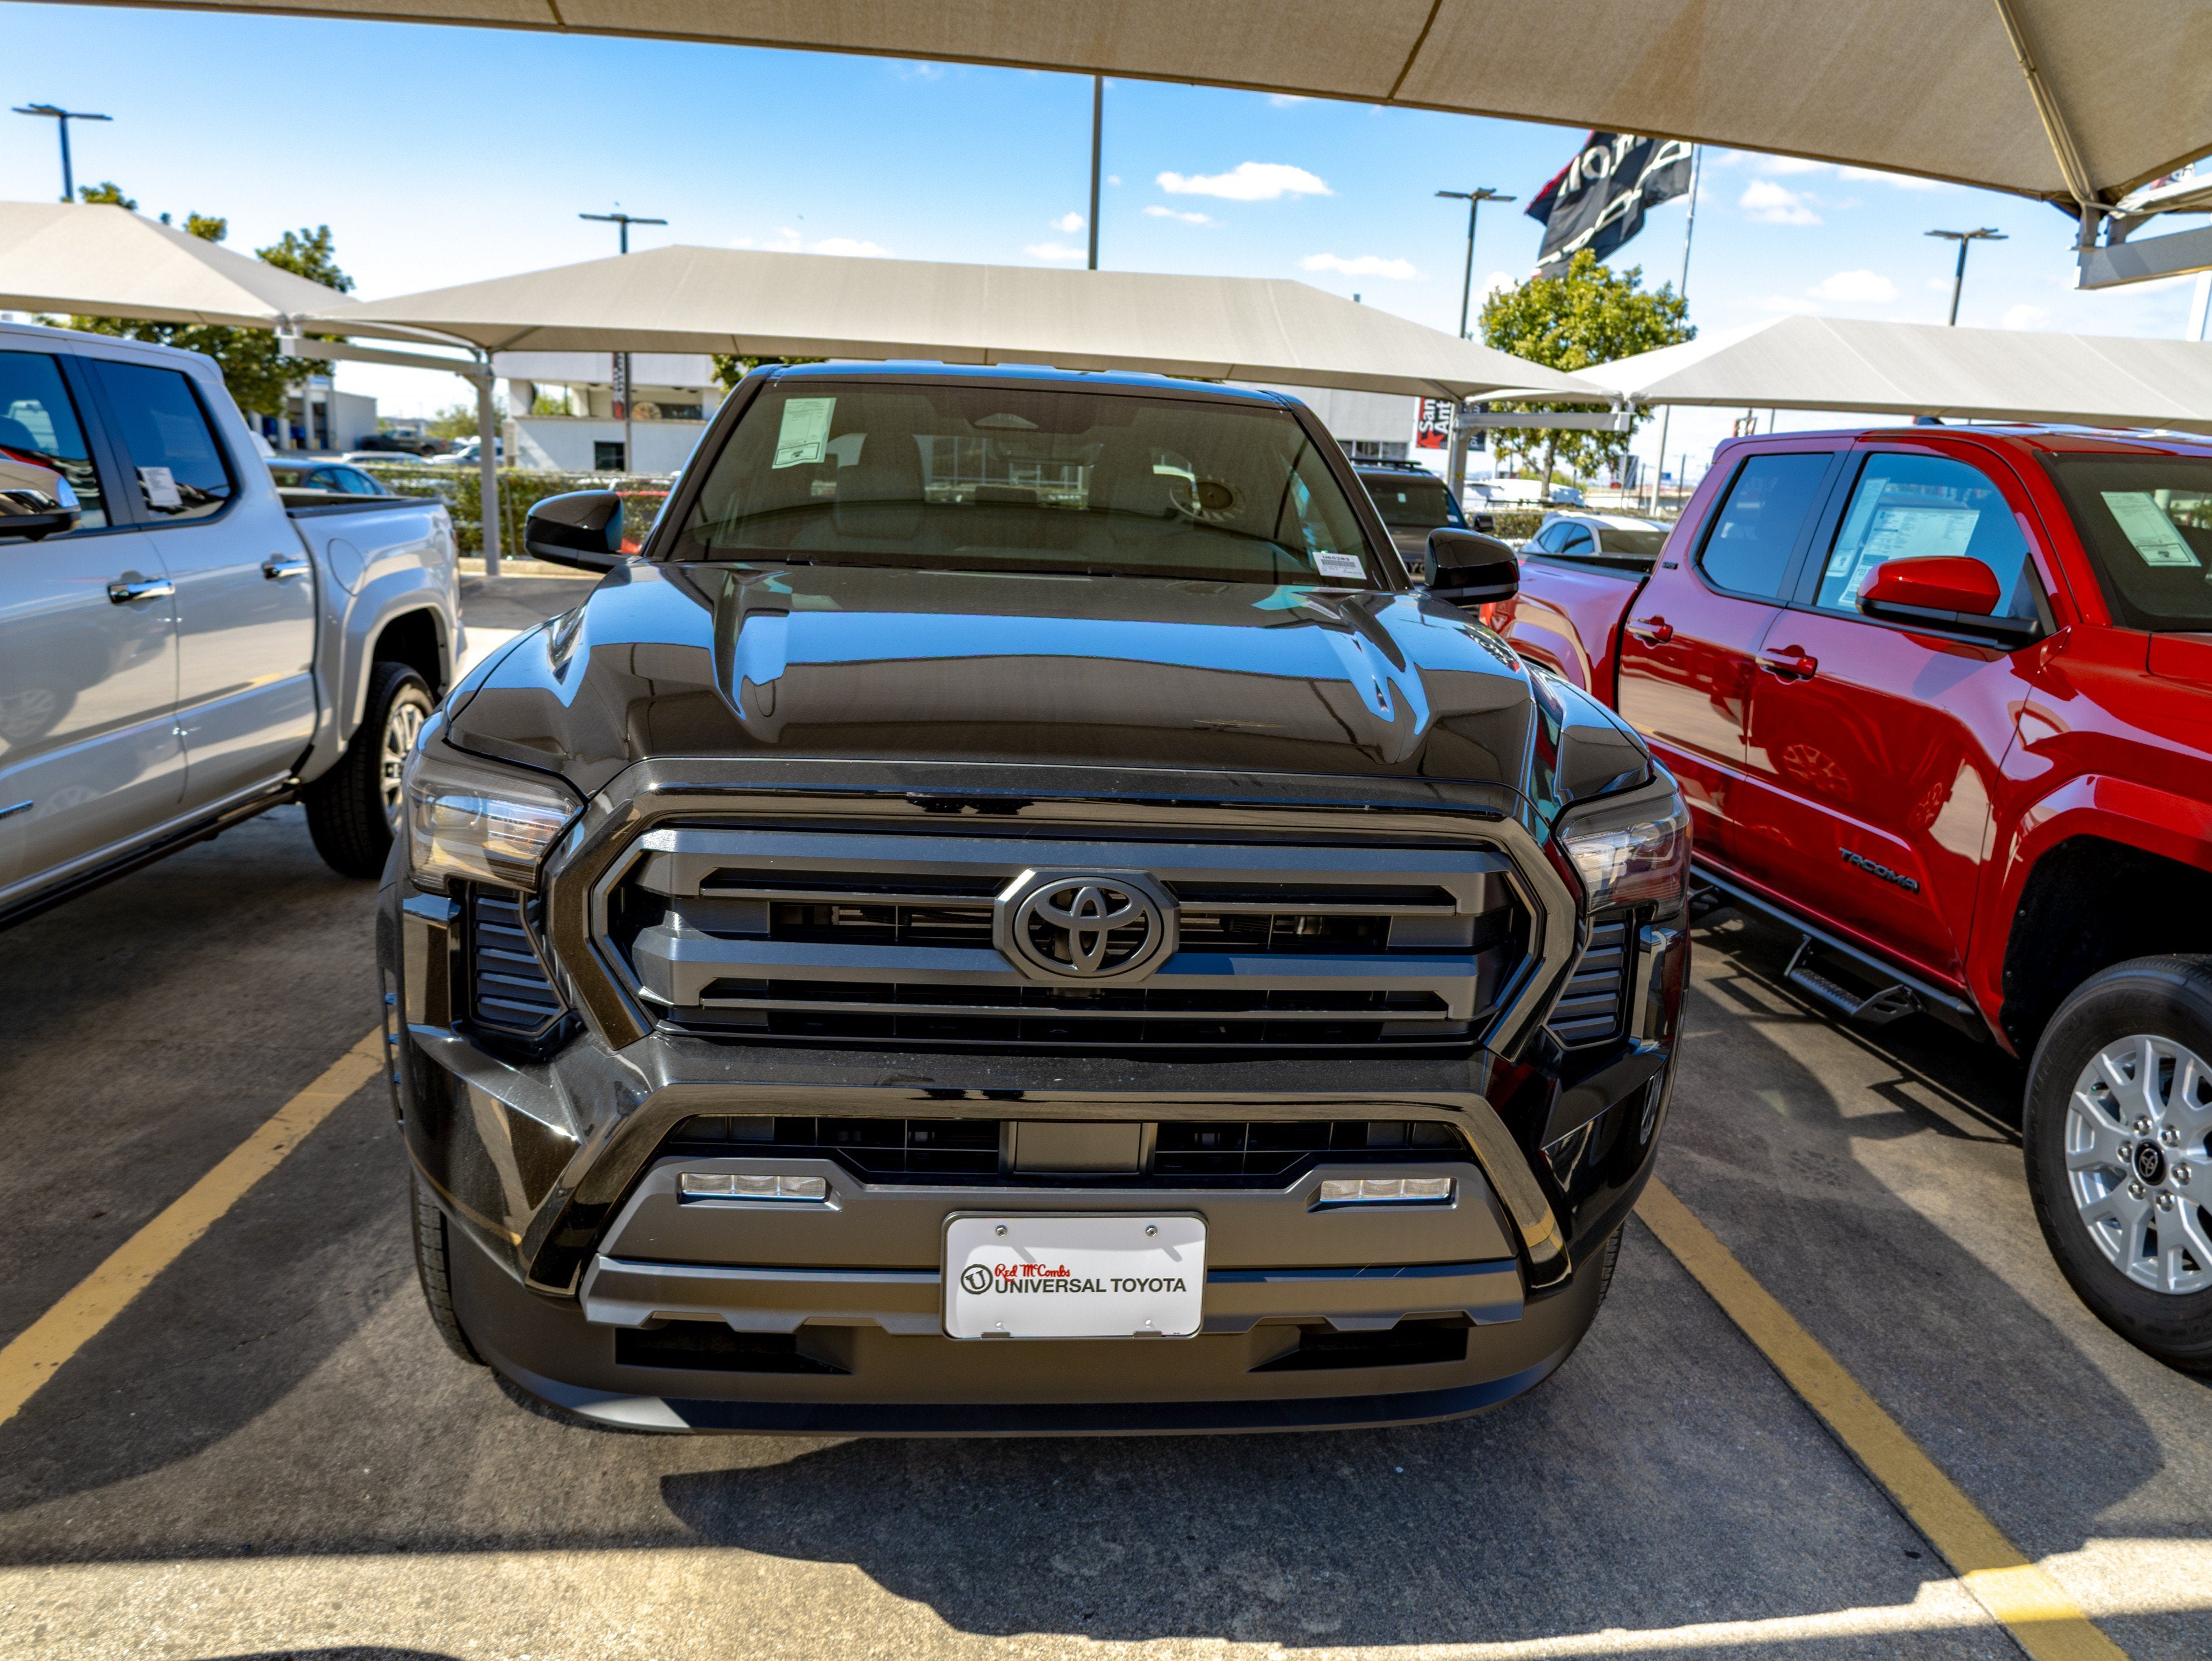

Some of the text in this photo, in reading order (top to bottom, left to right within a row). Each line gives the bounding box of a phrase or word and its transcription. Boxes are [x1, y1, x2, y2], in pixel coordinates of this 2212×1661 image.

[1419, 399, 1436, 433] San
[1839, 847, 1919, 894] TACOMA
[994, 1263, 1071, 1282] Red McCombs
[995, 1277, 1187, 1293] UNIVERSAL TOYOTA
